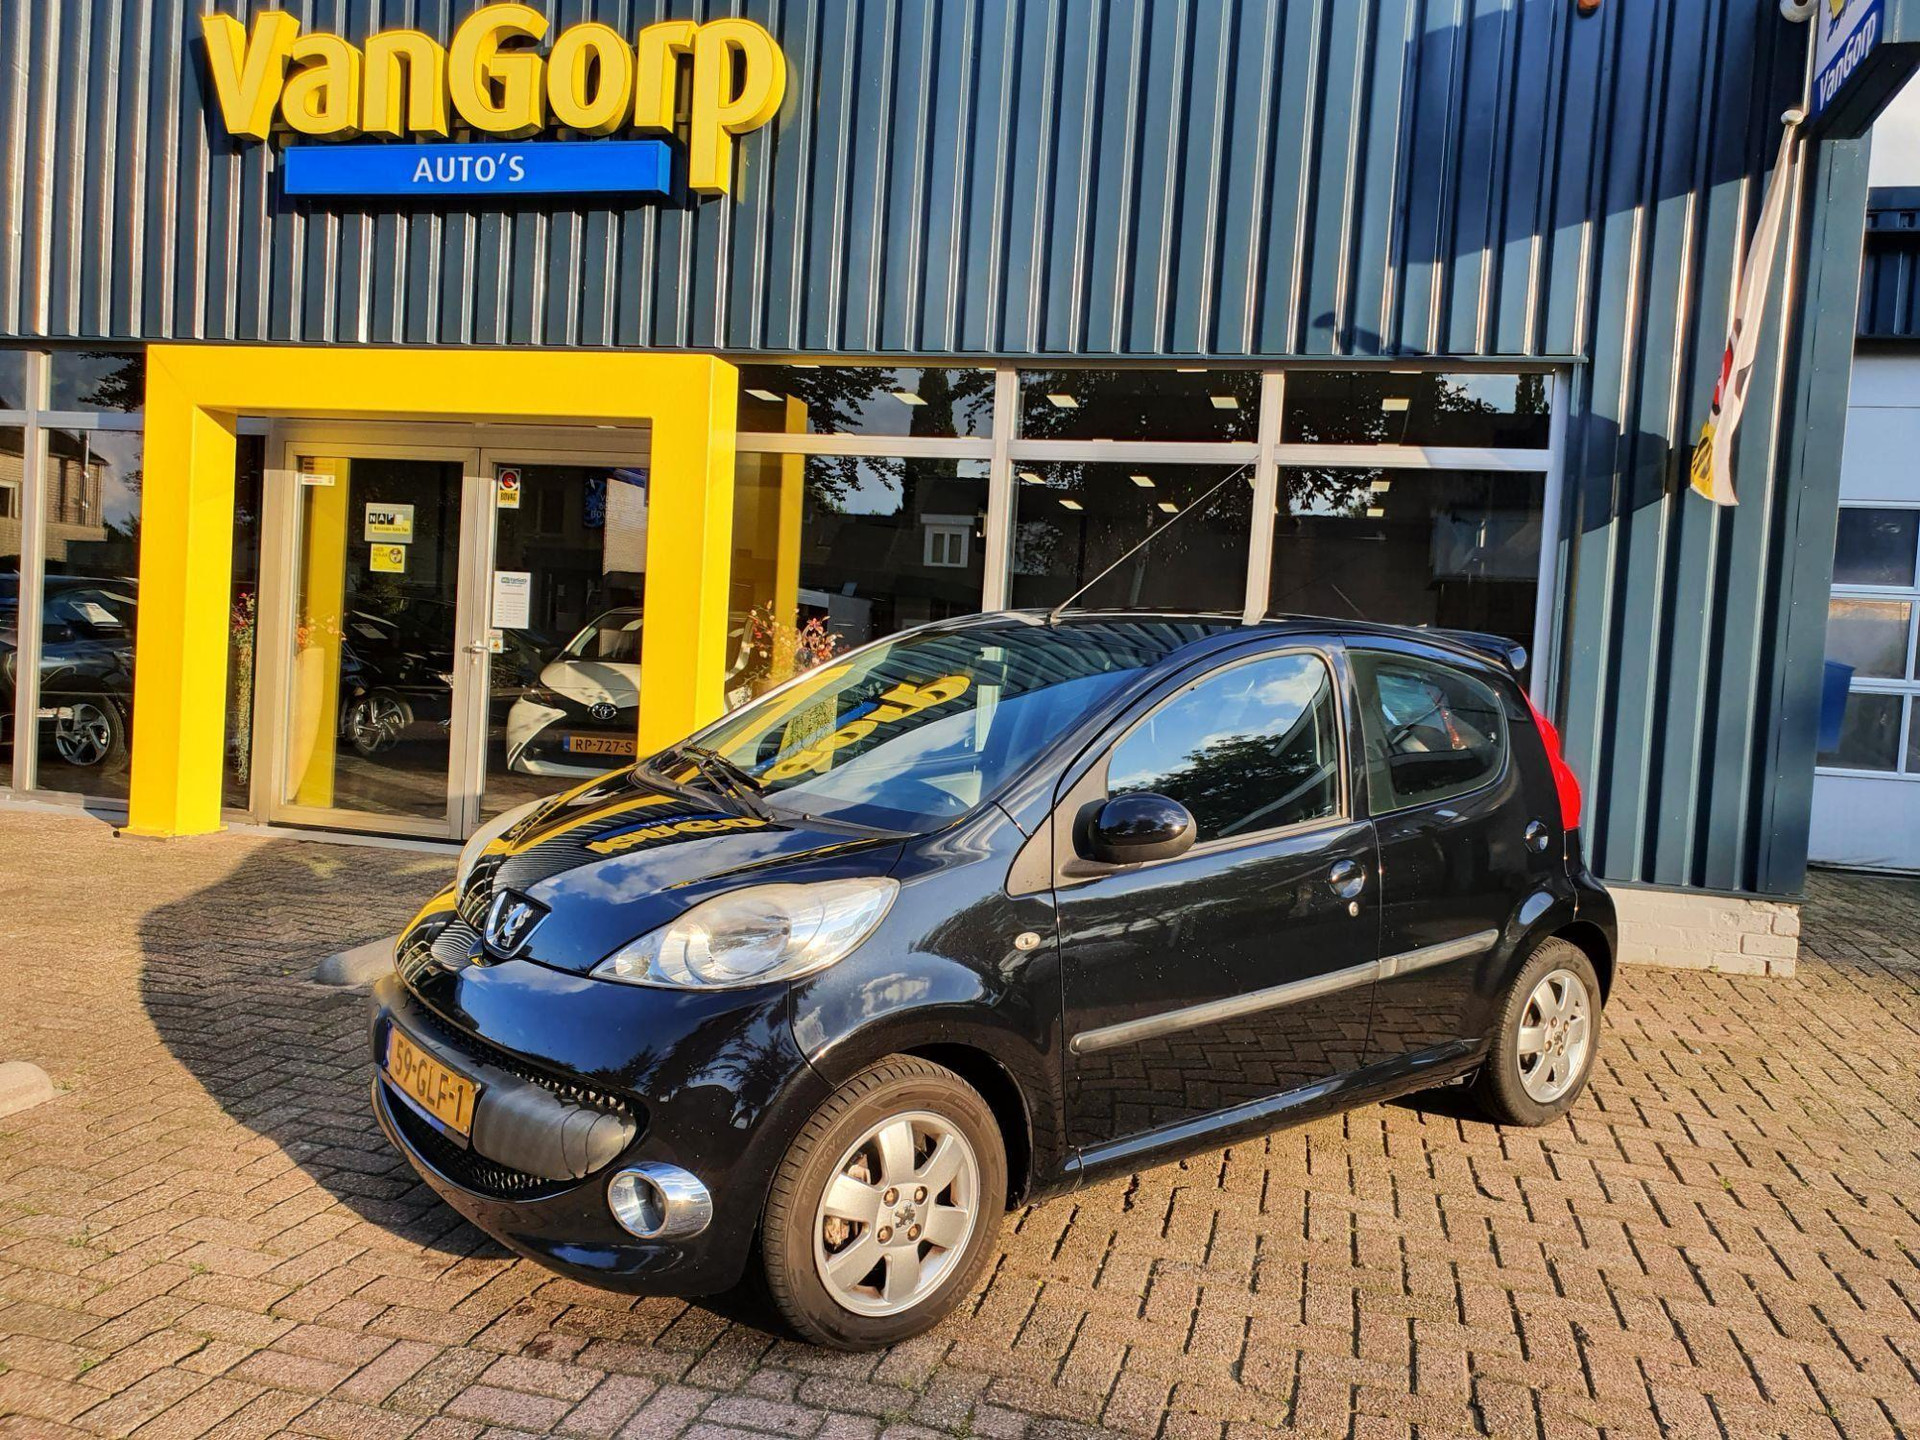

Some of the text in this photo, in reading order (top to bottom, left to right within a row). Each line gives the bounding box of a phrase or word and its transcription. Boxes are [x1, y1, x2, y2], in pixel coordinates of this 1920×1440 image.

[203, 4, 787, 195] VanGorp
[1819, 11, 1877, 111] VanGorp
[412, 152, 525, 183] AUTO'S
[575, 738, 633, 754] RP-727-S
[394, 1039, 464, 1123] 59-GLF-1
